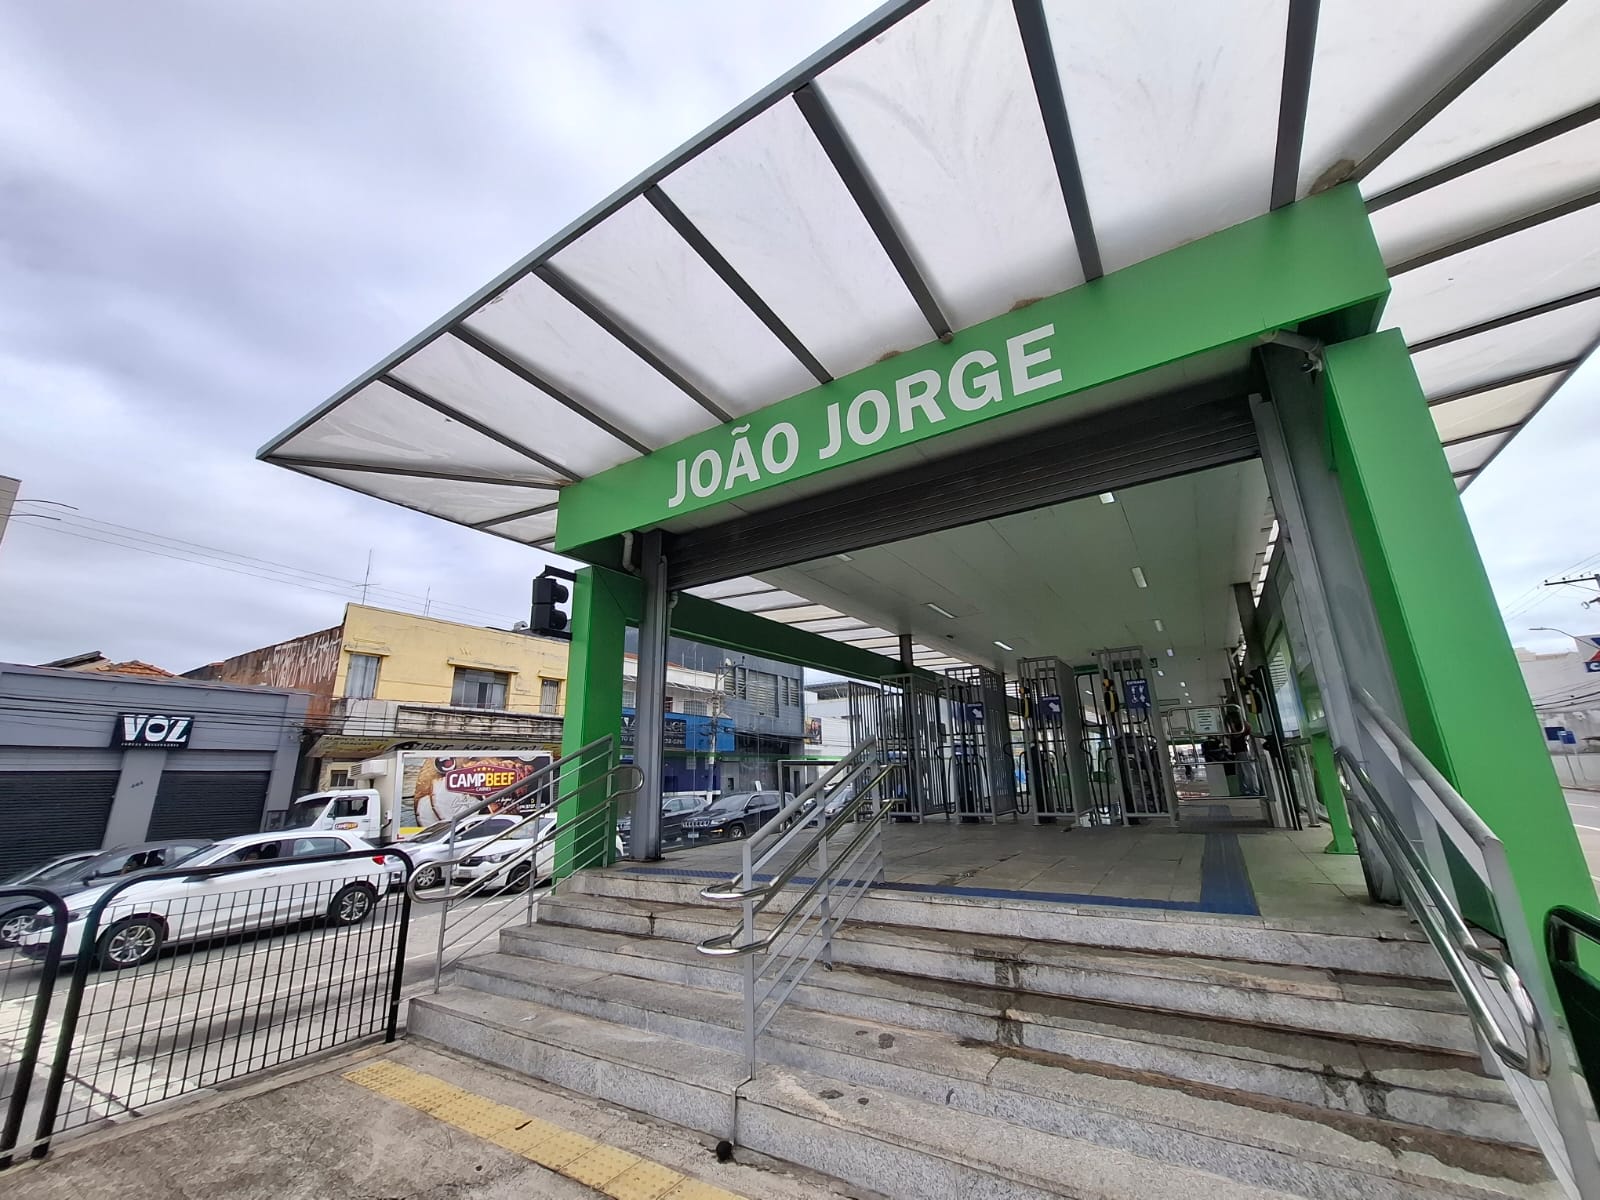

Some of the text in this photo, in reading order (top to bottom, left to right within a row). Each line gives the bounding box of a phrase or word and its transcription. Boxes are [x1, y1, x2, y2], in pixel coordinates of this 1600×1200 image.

[668, 323, 1063, 508] JOÃO JORGE
[122, 714, 191, 742] VOZ
[449, 772, 515, 788] CAMPBEEF
